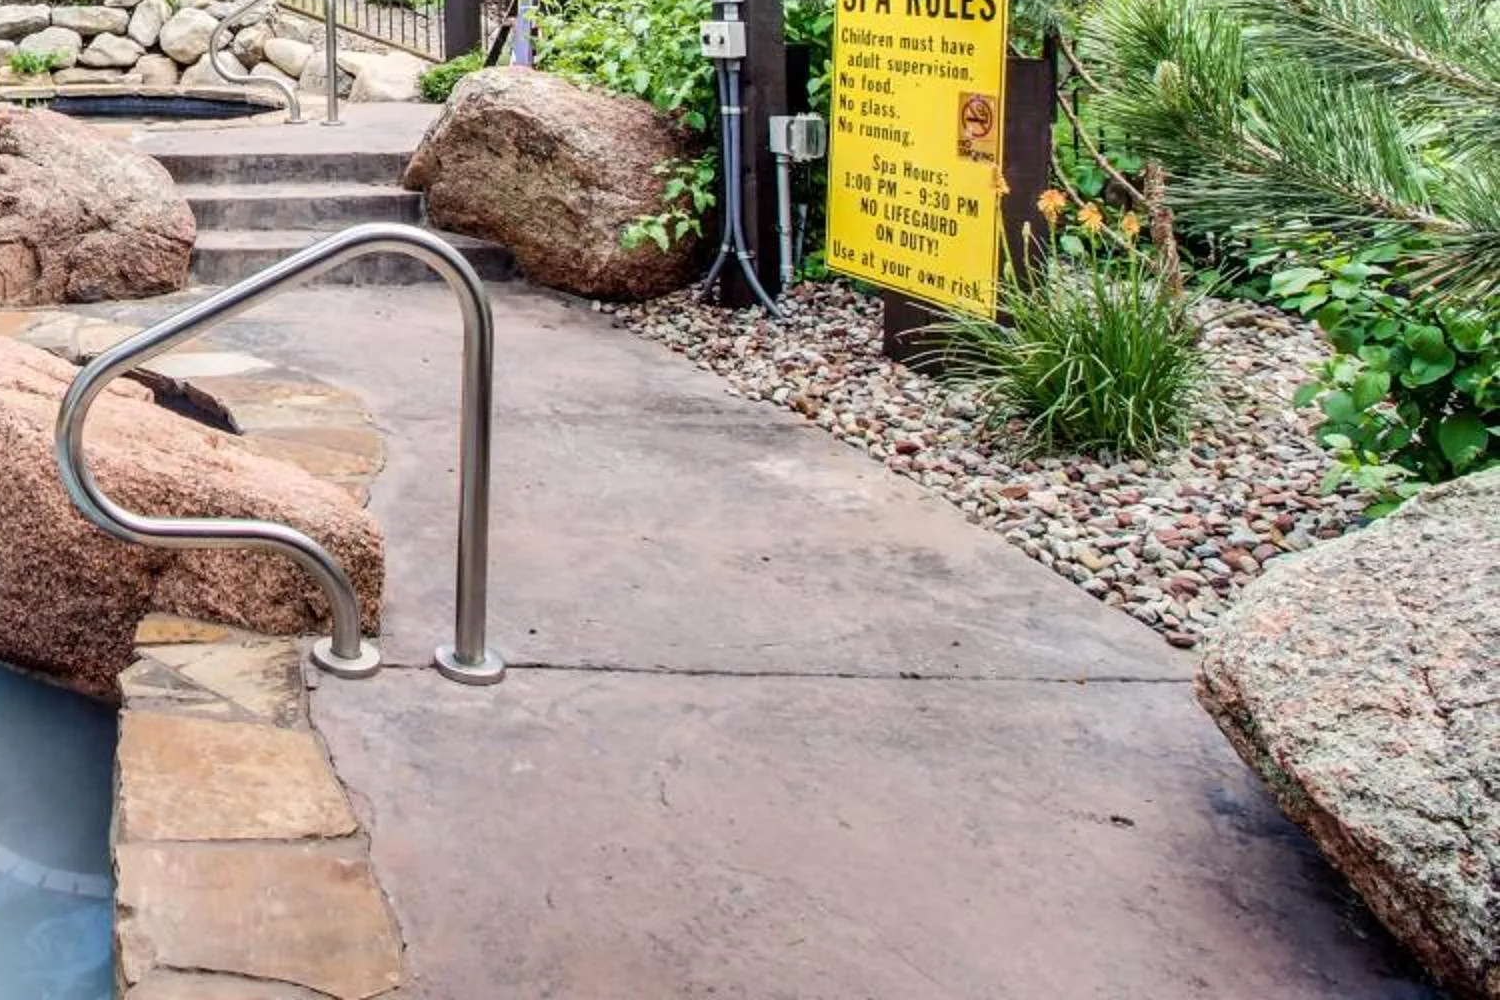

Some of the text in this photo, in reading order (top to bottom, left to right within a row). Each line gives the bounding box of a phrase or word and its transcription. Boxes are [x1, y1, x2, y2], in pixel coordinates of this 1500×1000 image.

[841, 28, 975, 56] Children must have
[848, 53, 974, 81] adult supervision.
[840, 72, 895, 95] No food.
[840, 94, 900, 119] No glass.
[838, 116, 915, 147] No running.
[872, 153, 949, 187] Spa Hours:
[845, 172, 871, 193] 1:00
[878, 179, 897, 198] PM
[919, 188, 950, 211] 9:30
[957, 197, 979, 218] PM
[860, 197, 957, 237] NO LIFEGAURD
[876, 223, 939, 257] ON DUTY!
[833, 240, 985, 304] Use at your own risk.
